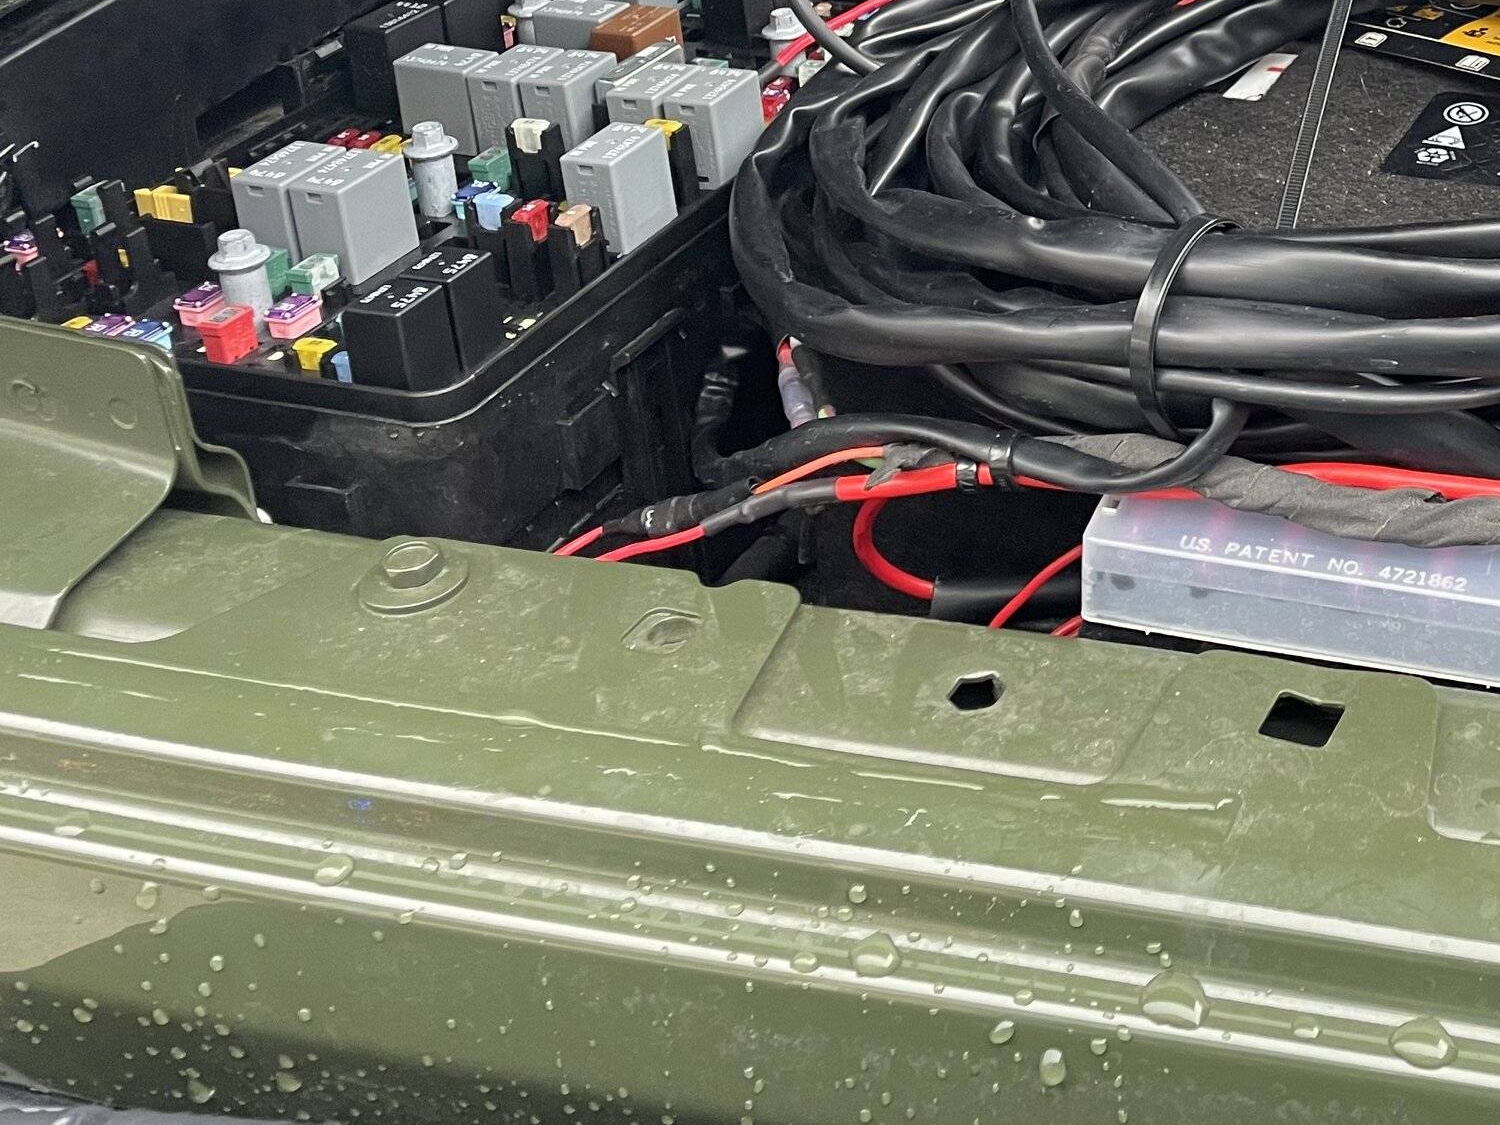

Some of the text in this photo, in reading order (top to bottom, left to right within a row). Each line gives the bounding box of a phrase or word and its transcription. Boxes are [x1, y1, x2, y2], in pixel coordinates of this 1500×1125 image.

[1223, 541, 1315, 567] PATENT
[1327, 557, 1364, 577] NO.
[1377, 565, 1468, 592] 4721862
